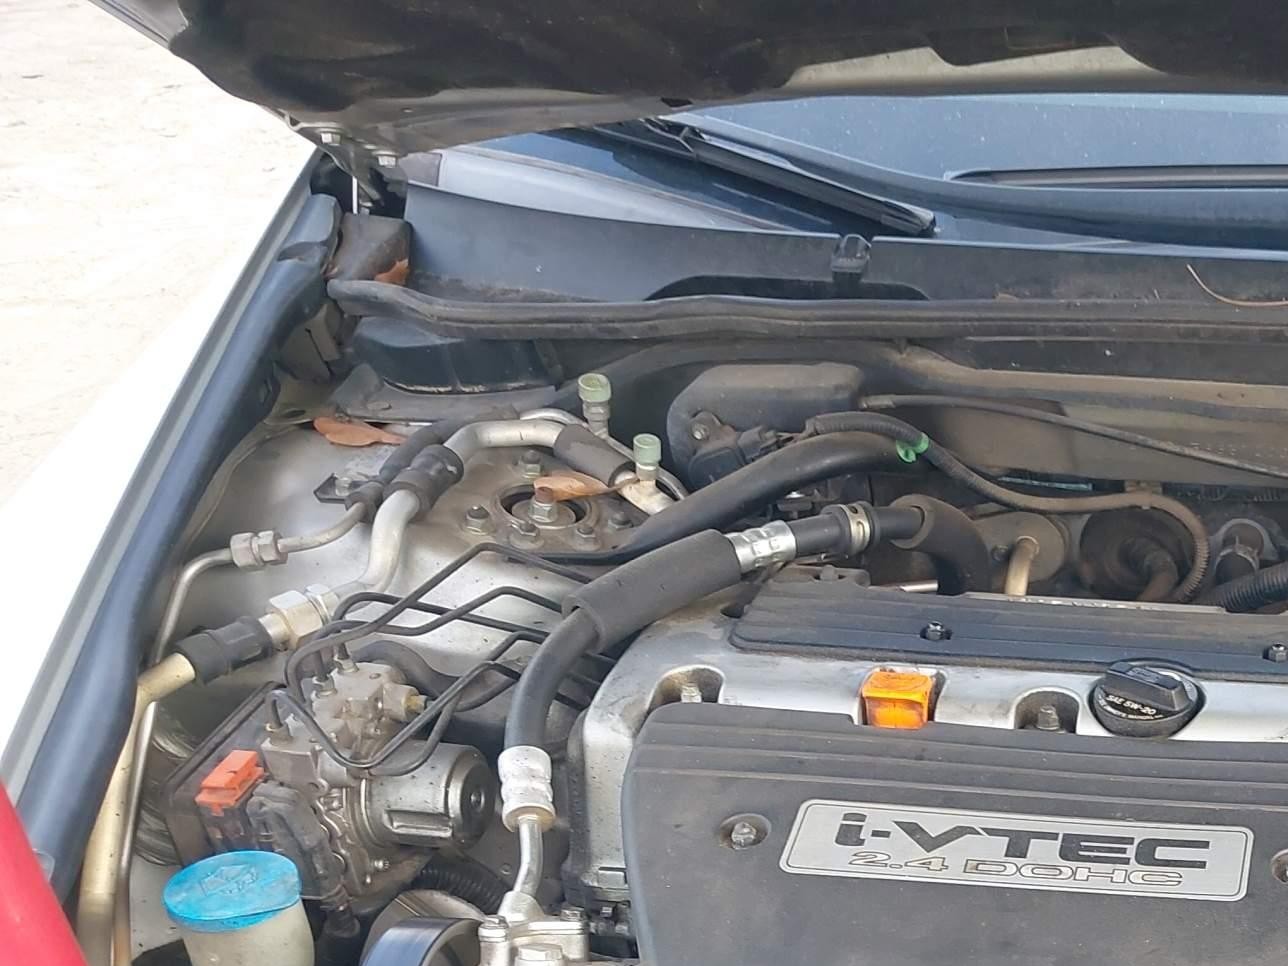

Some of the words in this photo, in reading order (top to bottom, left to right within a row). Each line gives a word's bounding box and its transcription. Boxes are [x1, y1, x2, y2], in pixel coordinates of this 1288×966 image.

[1107, 694, 1124, 705] SAE
[1125, 699, 1157, 714] 5W-20
[834, 812, 1212, 869] i-VTEC
[847, 850, 949, 872] 2.4
[962, 858, 1186, 887] DOHC
